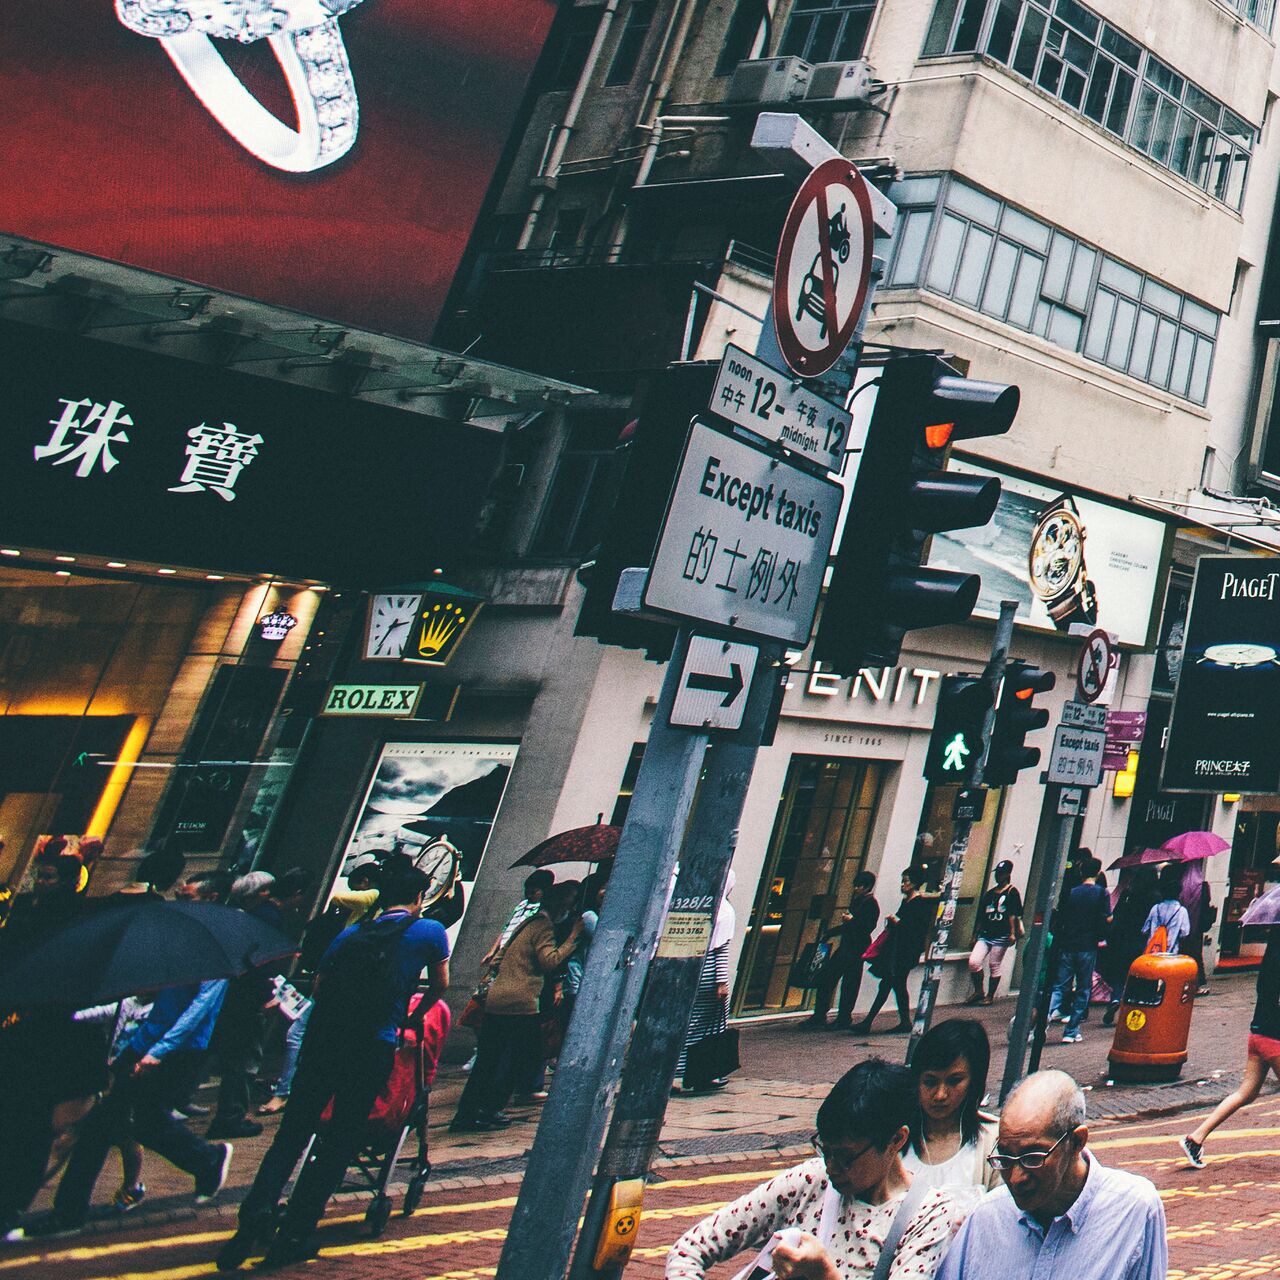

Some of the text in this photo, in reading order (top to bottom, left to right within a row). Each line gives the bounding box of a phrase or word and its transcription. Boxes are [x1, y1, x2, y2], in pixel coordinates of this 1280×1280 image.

[727, 357, 754, 382] noon
[719, 383, 747, 414] 中午
[796, 398, 819, 429] 午夜
[822, 416, 846, 458] 12
[32, 397, 265, 503] 珠寶
[780, 422, 819, 454] midnight
[698, 454, 823, 539] Except taxis
[682, 525, 802, 612] 的士例外
[1220, 572, 1280, 601] PIAGET
[327, 689, 416, 710] ROLEX
[824, 733, 852, 745] SINCE
[1059, 733, 1084, 751] Except
[1083, 738, 1100, 753] taxis
[668, 926, 705, 935] 2333 3762
